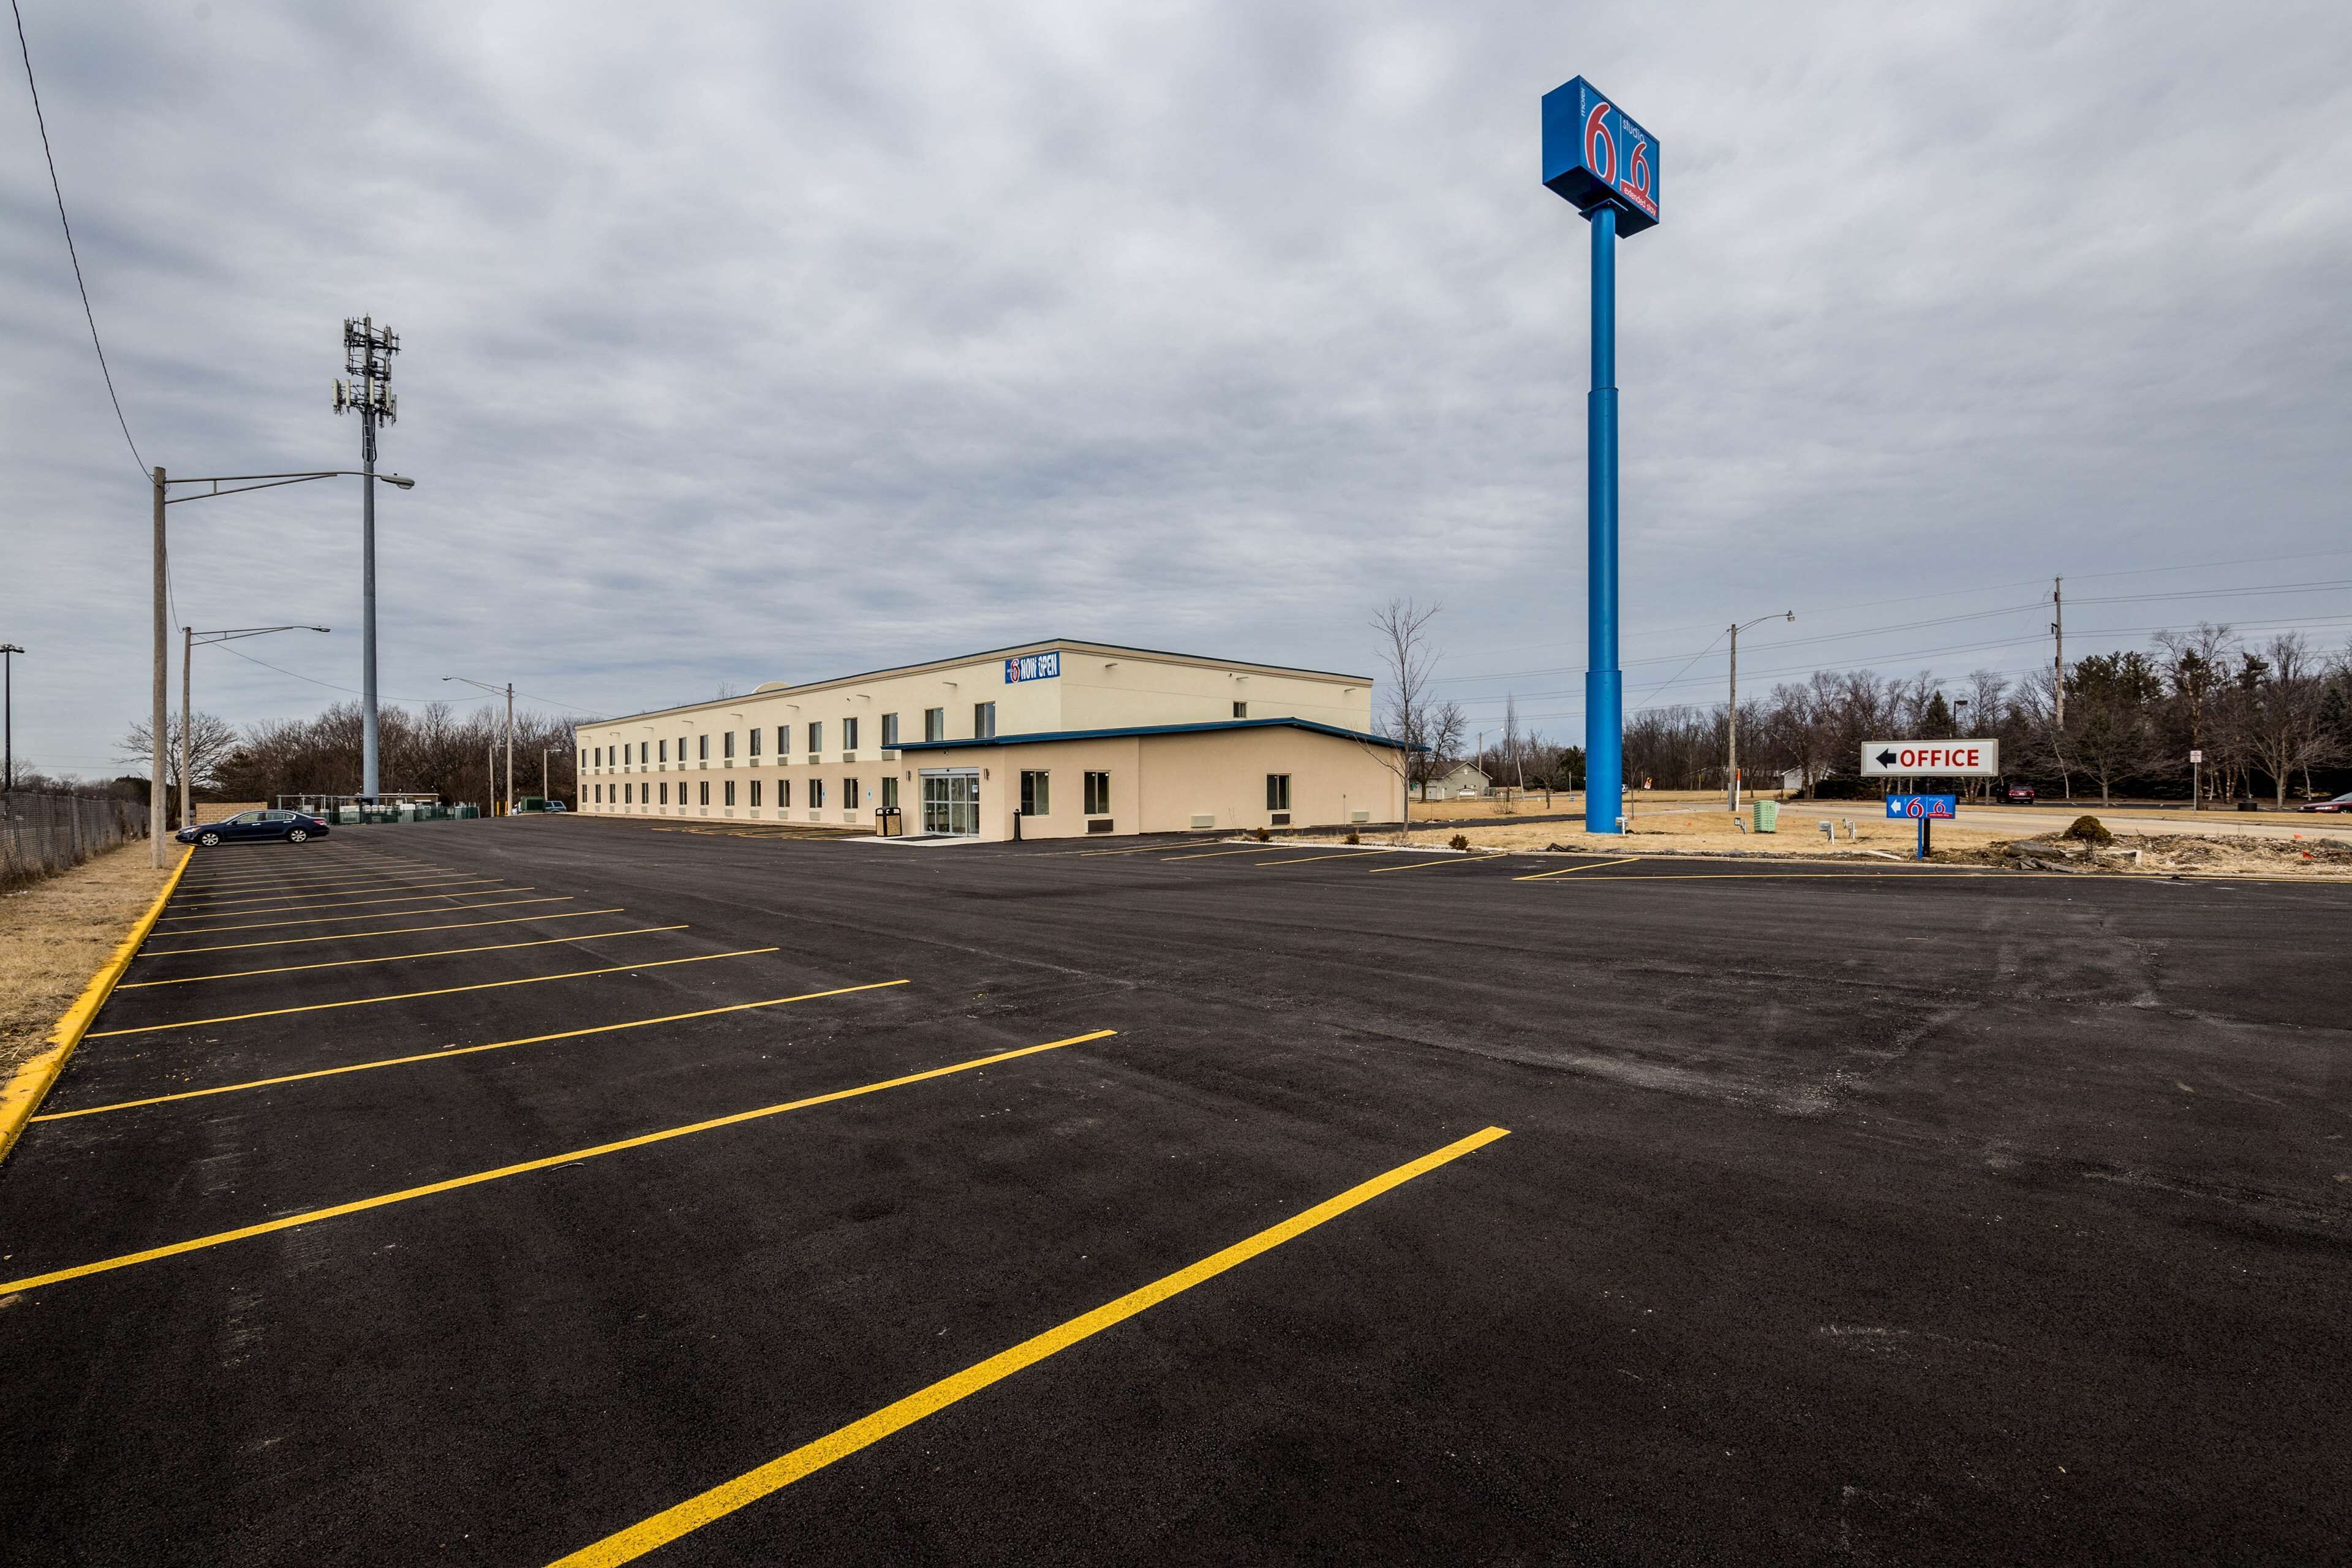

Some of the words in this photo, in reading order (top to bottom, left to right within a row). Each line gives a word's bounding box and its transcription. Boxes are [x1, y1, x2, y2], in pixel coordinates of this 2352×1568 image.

[1585, 102, 1616, 185] 6
[1623, 119, 1645, 143] studio
[1630, 142, 1650, 194] 6
[1624, 187, 1646, 208] extended
[1646, 203, 1656, 216] stay
[1011, 658, 1020, 682] 6
[1021, 657, 1036, 680] NOW
[1038, 654, 1057, 677] OPEN
[1900, 749, 1979, 767] OFFICE
[1906, 797, 1924, 818] 6
[1933, 799, 1945, 814] 6
